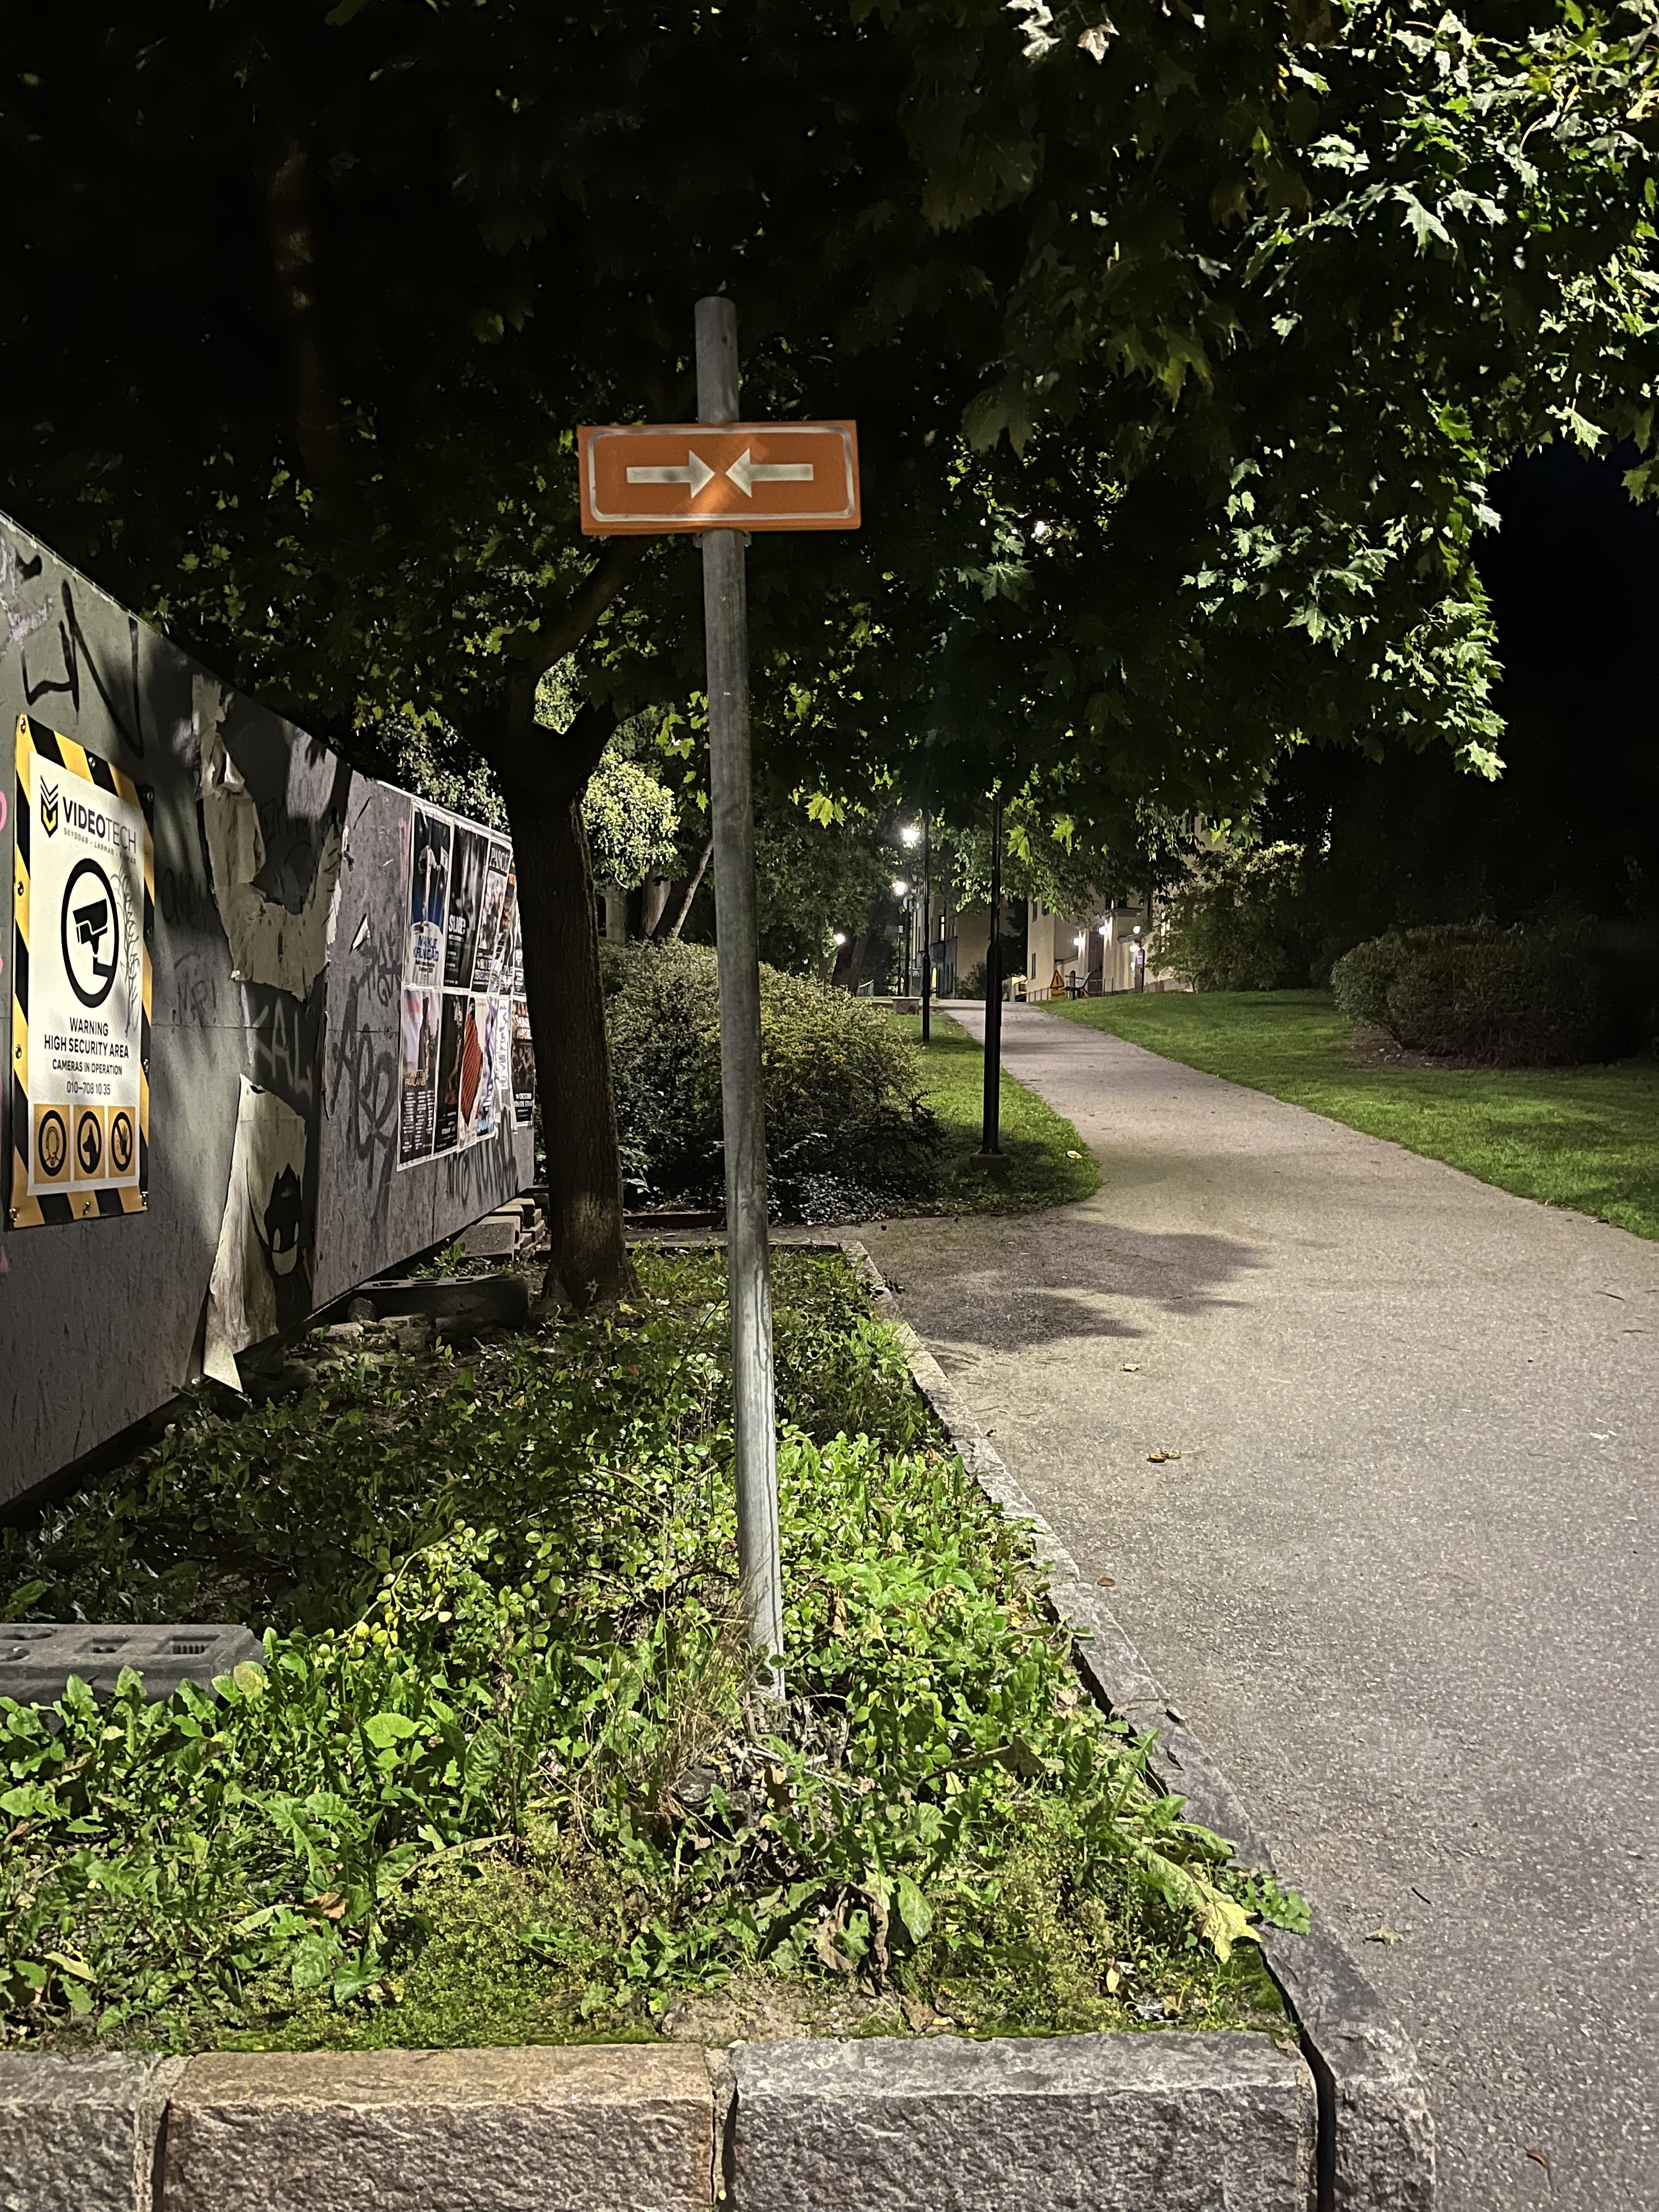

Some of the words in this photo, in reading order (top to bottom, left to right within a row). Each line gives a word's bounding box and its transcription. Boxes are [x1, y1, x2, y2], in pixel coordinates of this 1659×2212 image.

[63, 796, 136, 854] VIDEOTECH
[69, 1017, 109, 1037] WARNING
[44, 1034, 67, 1052] HIGH
[69, 1037, 108, 1057] SECURITY
[109, 1043, 129, 1059] AREA
[52, 1058, 83, 1072] CAMERAS
[84, 1062, 90, 1073] IN
[91, 1063, 122, 1075] OPERATION
[95, 1083, 102, 1095] 10
[103, 1083, 111, 1096] 35
